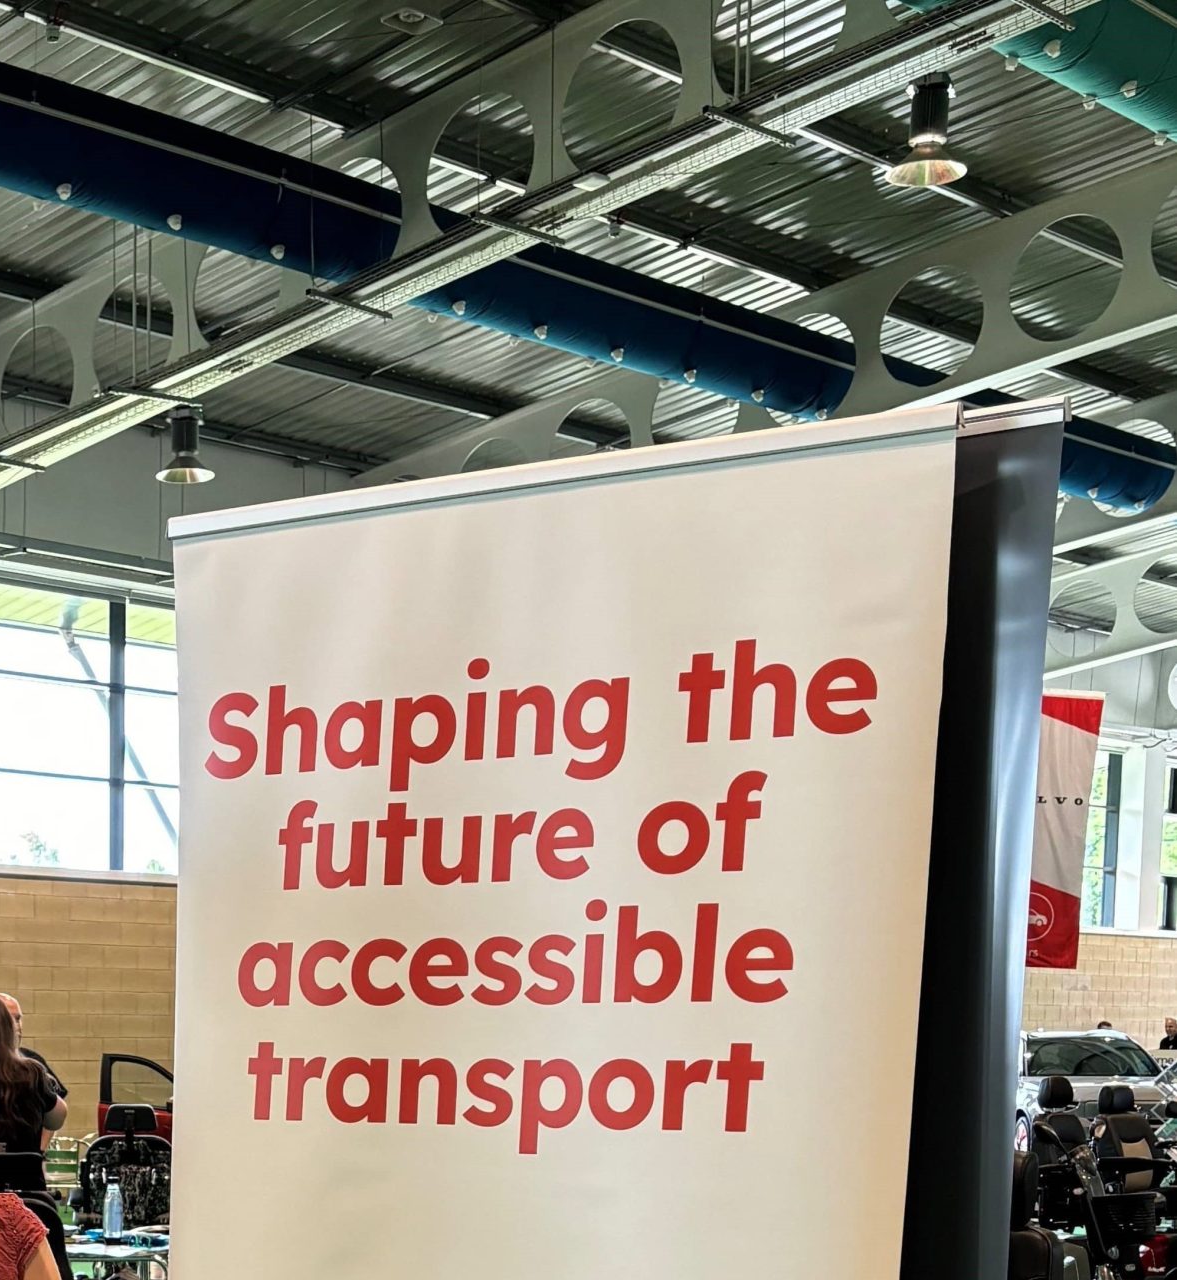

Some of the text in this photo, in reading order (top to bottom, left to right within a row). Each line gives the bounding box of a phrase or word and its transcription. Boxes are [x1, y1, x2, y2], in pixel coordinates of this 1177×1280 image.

[204, 638, 878, 792] Shaping the
[278, 770, 768, 890] future of
[1037, 796, 1083, 805] LVO
[237, 899, 794, 1007] accessible
[247, 1042, 765, 1155] transport
